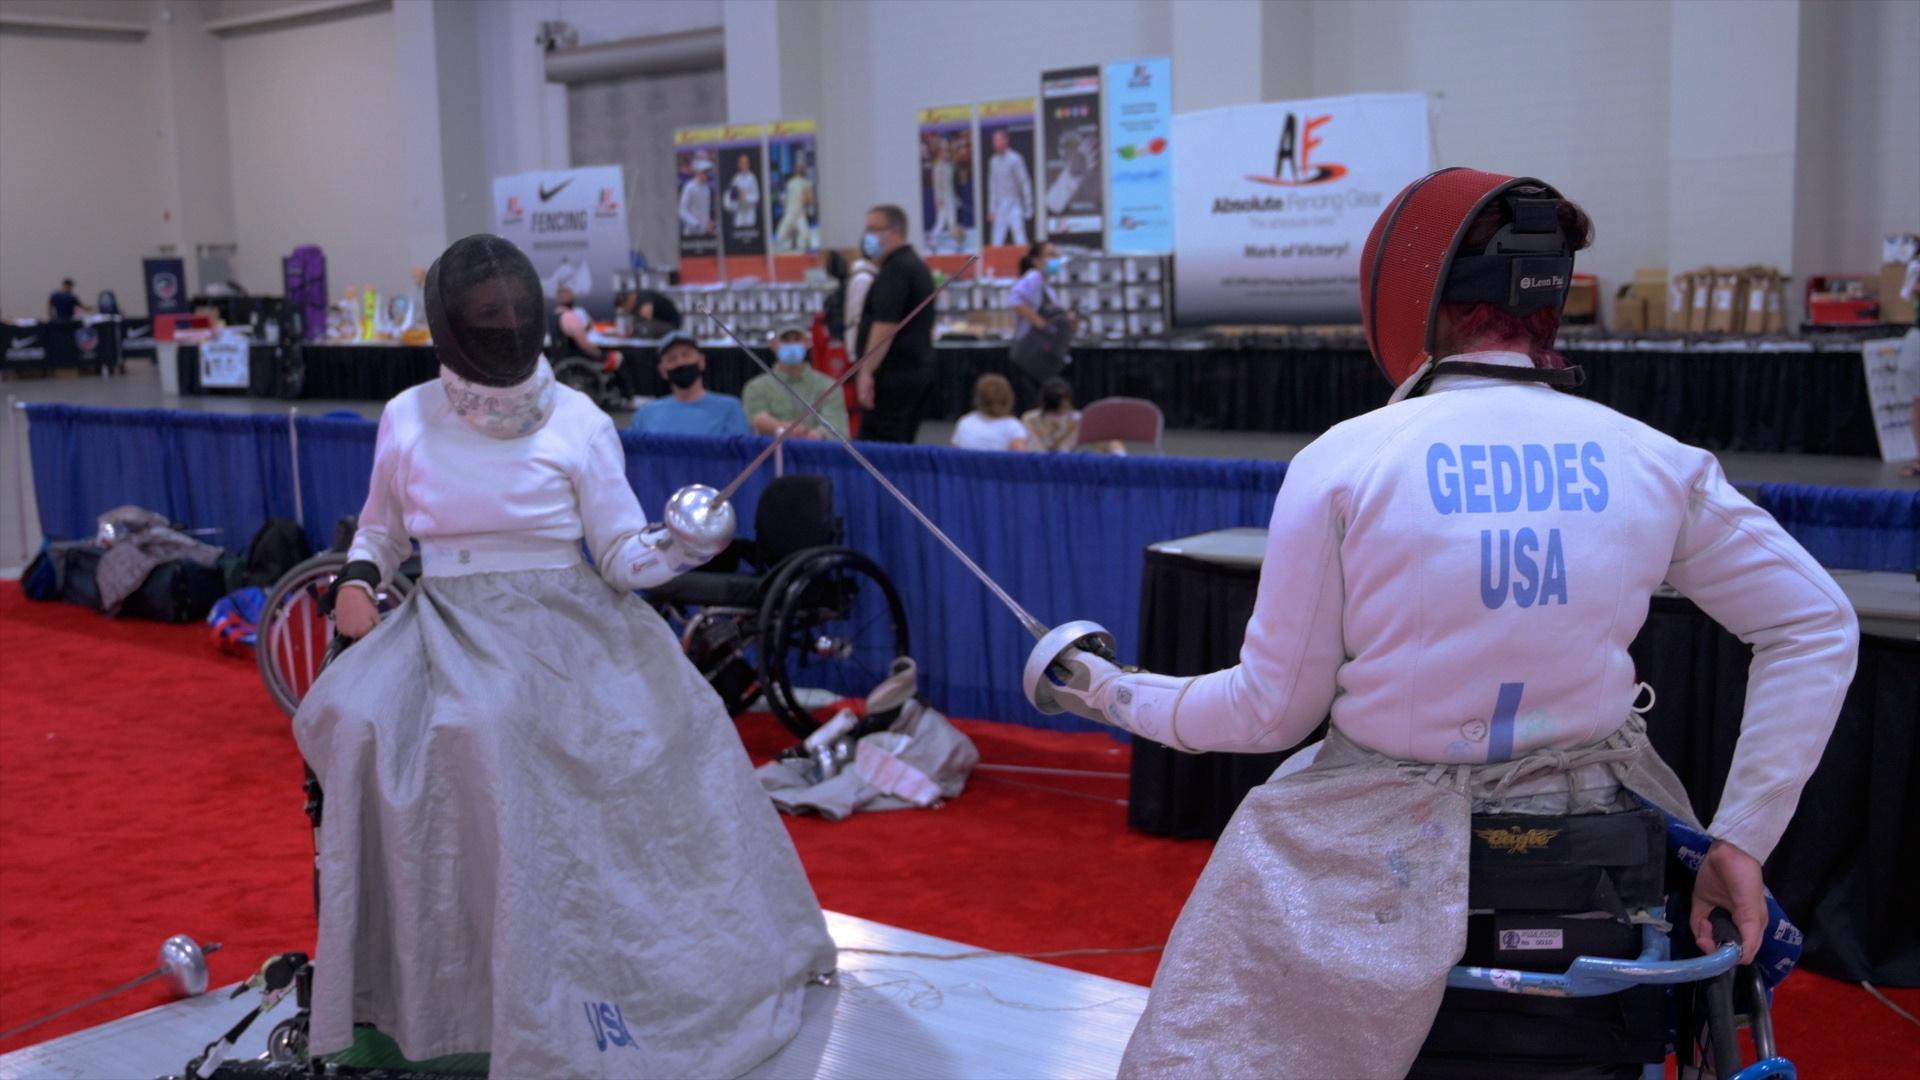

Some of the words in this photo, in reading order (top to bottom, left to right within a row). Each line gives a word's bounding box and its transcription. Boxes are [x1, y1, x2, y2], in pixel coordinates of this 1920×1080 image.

[1211, 195, 1283, 213] Absolute
[1287, 192, 1343, 217] Fencing
[1347, 188, 1381, 207] Gear
[532, 210, 588, 233] FENCING
[1244, 244, 1277, 257] Mark
[1531, 277, 1551, 288] Leon
[1426, 441, 1609, 515] GEDDES
[1480, 527, 1568, 610] USA
[583, 1001, 640, 1052] USA
